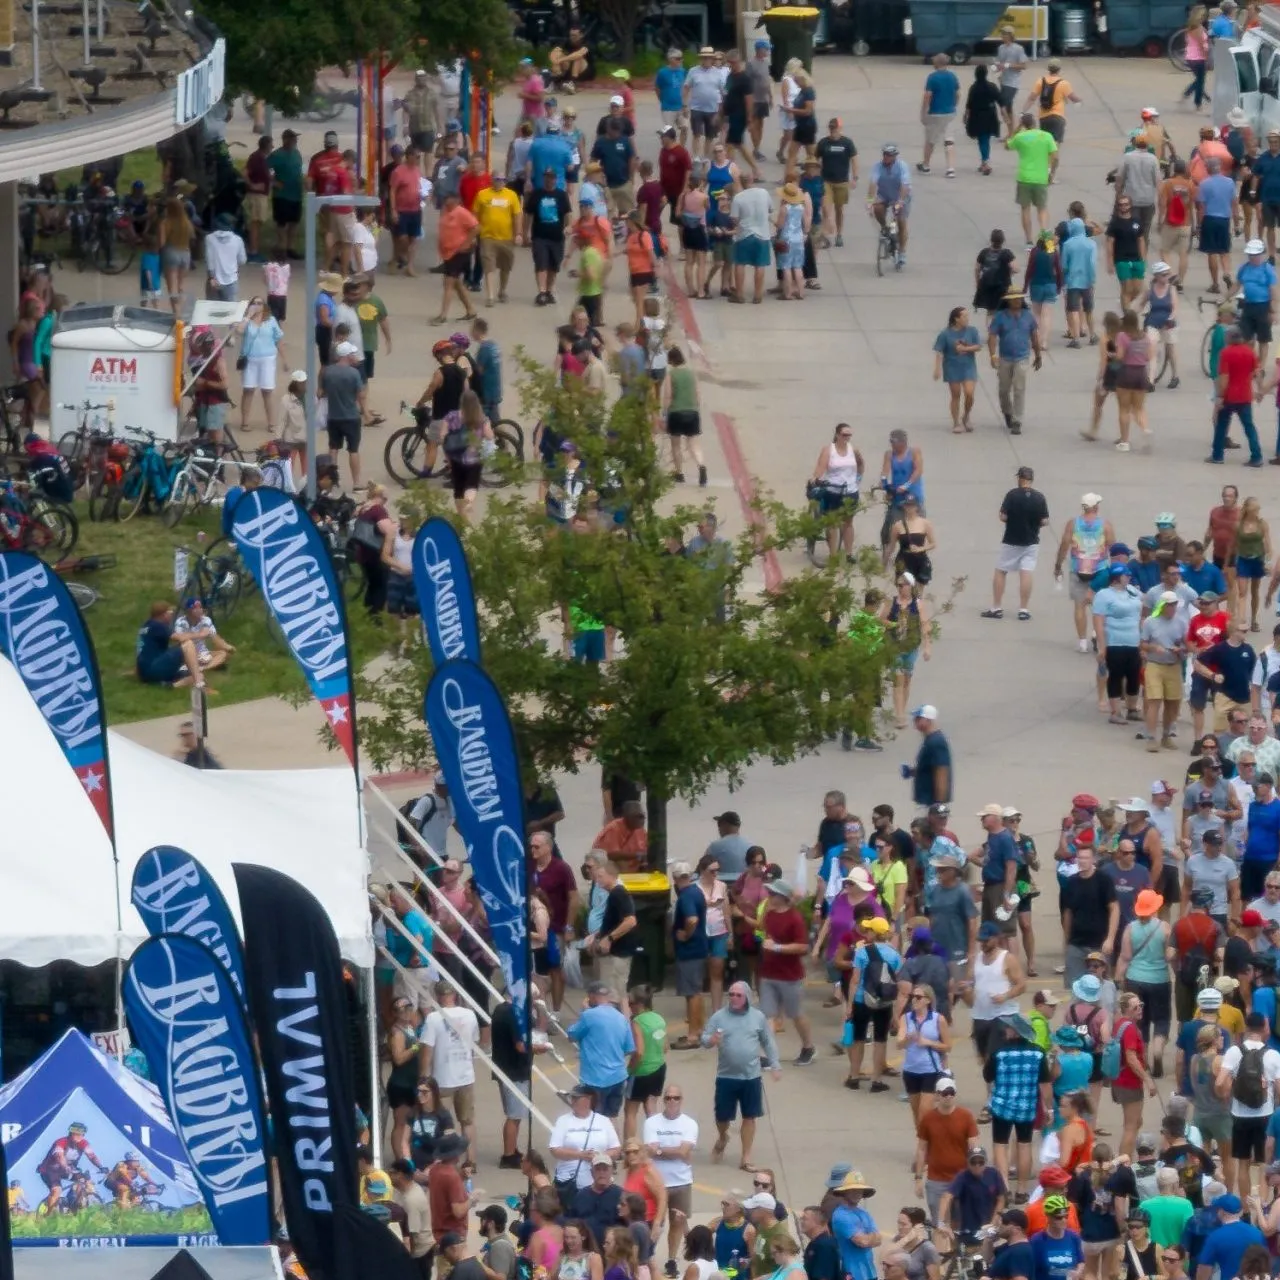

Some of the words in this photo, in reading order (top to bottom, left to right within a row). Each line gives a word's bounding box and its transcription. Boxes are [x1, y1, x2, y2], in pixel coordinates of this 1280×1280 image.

[89, 374, 137, 383] INSIDE
[90, 357, 137, 374] ATM
[0, 556, 102, 750] RAGBRAI
[234, 494, 349, 682] RAGBRAI
[442, 678, 504, 823] RAGBRAI
[131, 955, 268, 1208] RAGBRAI
[273, 971, 335, 1213] PRIMAL
